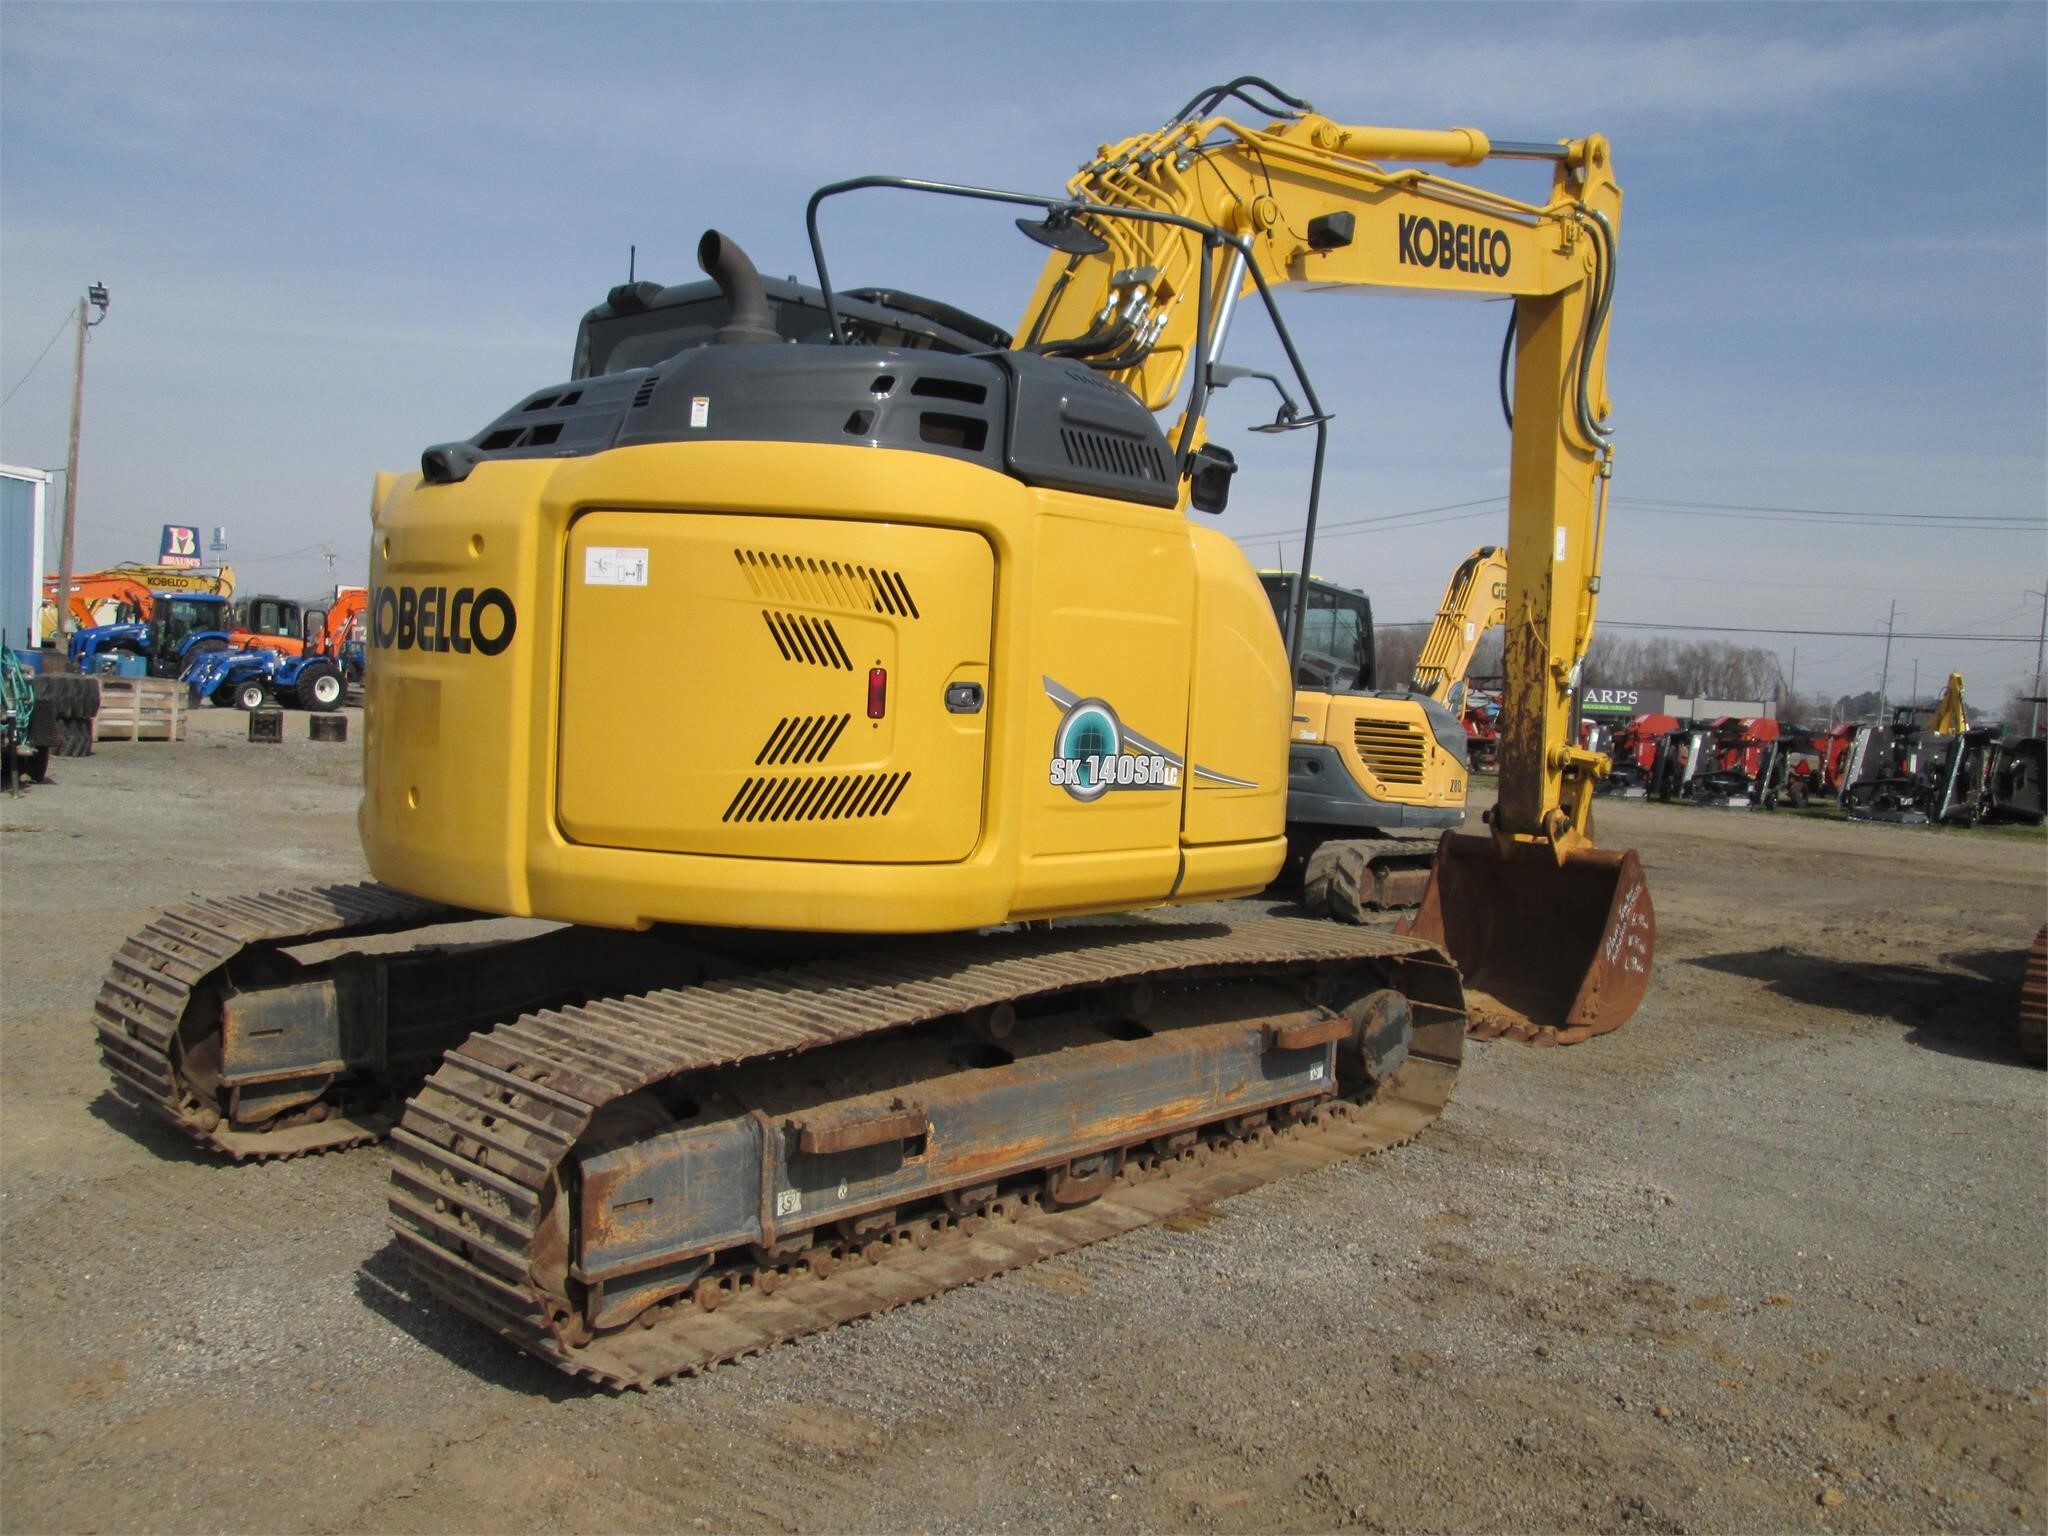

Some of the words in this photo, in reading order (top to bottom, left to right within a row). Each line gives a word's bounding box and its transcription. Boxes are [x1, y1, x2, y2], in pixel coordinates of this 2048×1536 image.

[1399, 212, 1511, 277] KOBELCO
[147, 577, 189, 588] KOBELCO
[1050, 758, 1081, 785] SK
